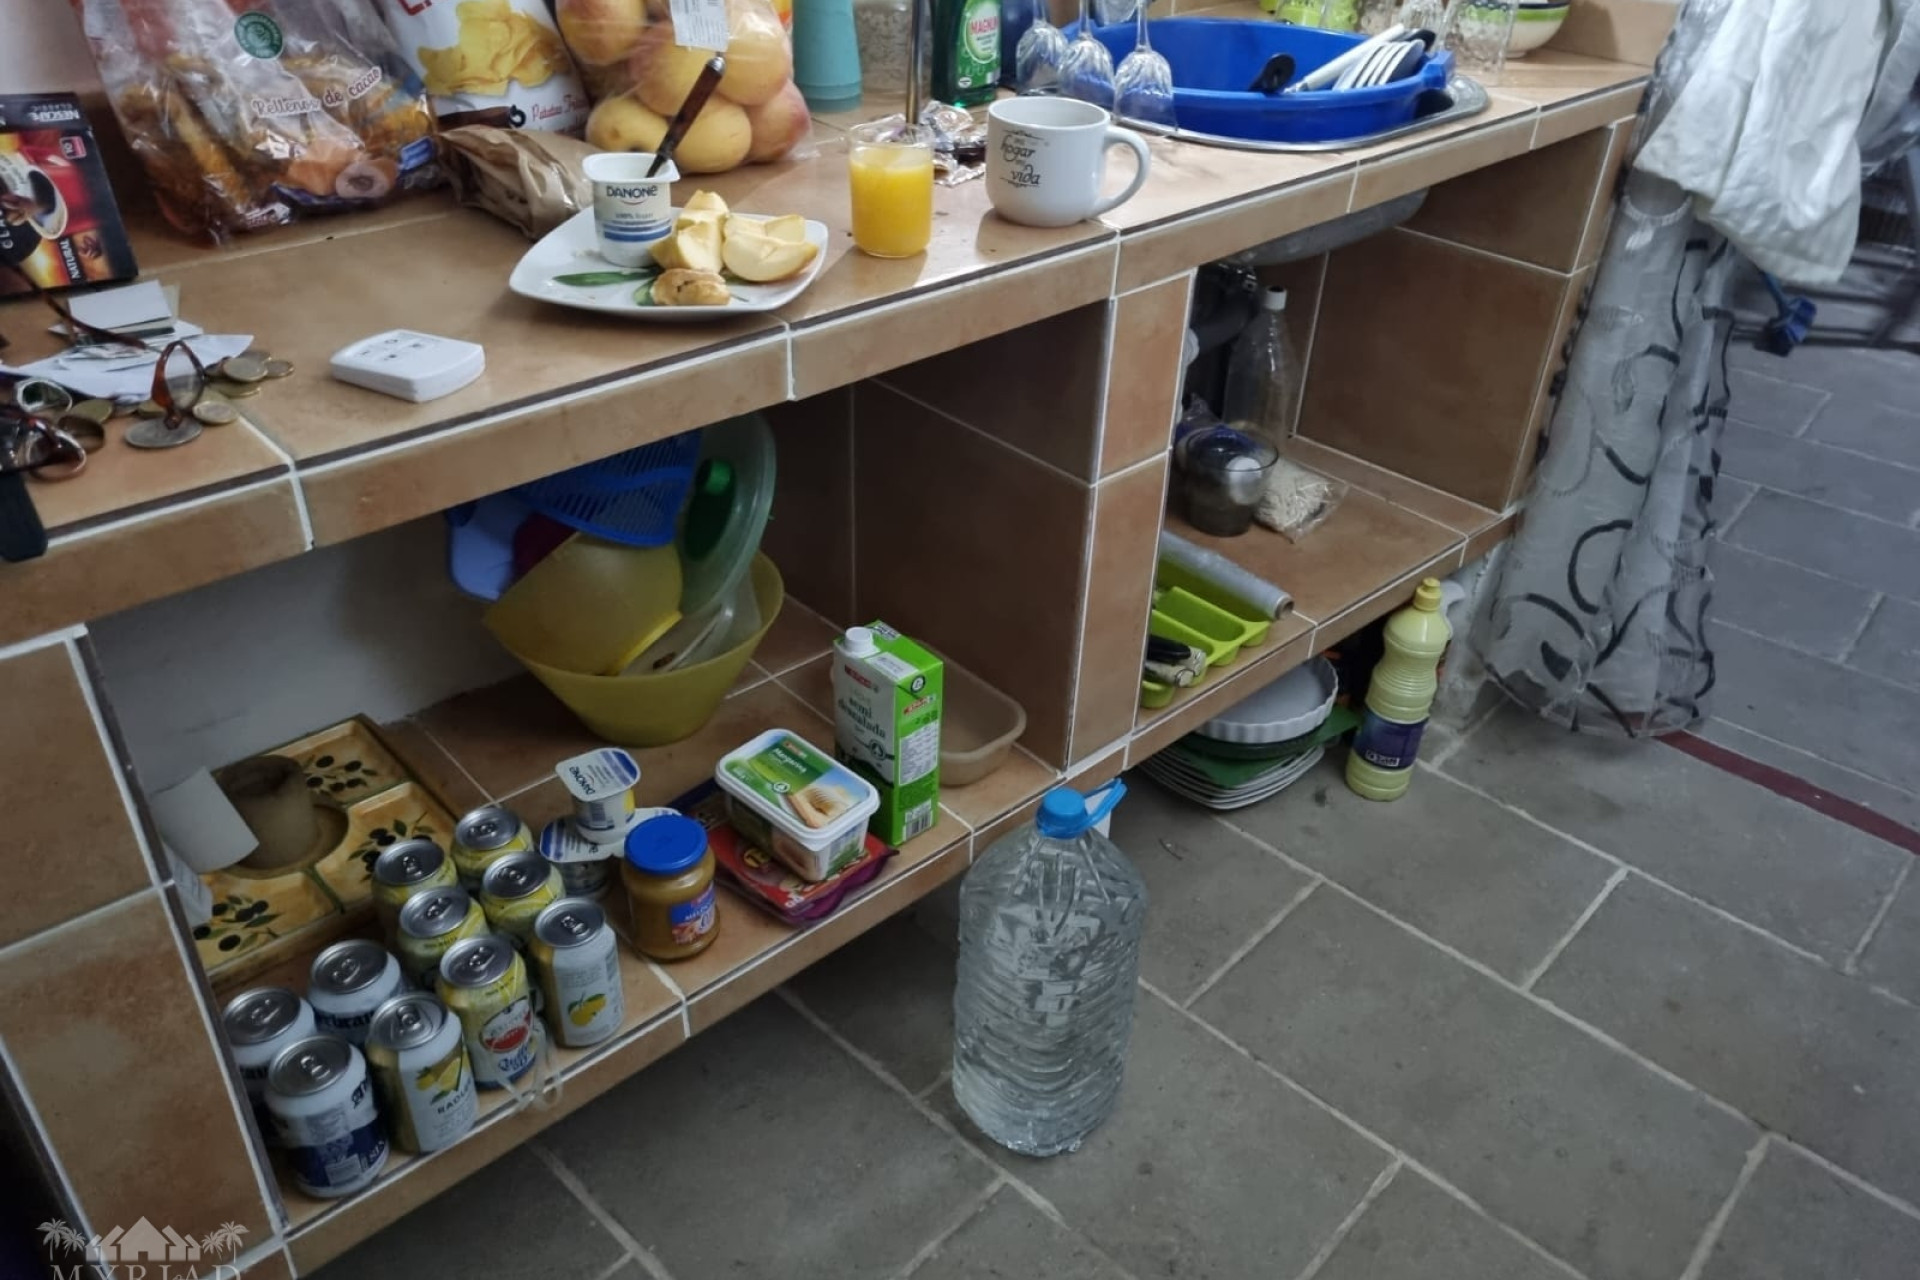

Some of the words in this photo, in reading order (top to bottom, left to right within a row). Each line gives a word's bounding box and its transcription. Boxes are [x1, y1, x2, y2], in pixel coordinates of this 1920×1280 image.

[324, 88, 345, 106] de
[348, 66, 381, 98] cacao
[606, 184, 659, 199] DANONE
[60, 237, 81, 279] NATURAL
